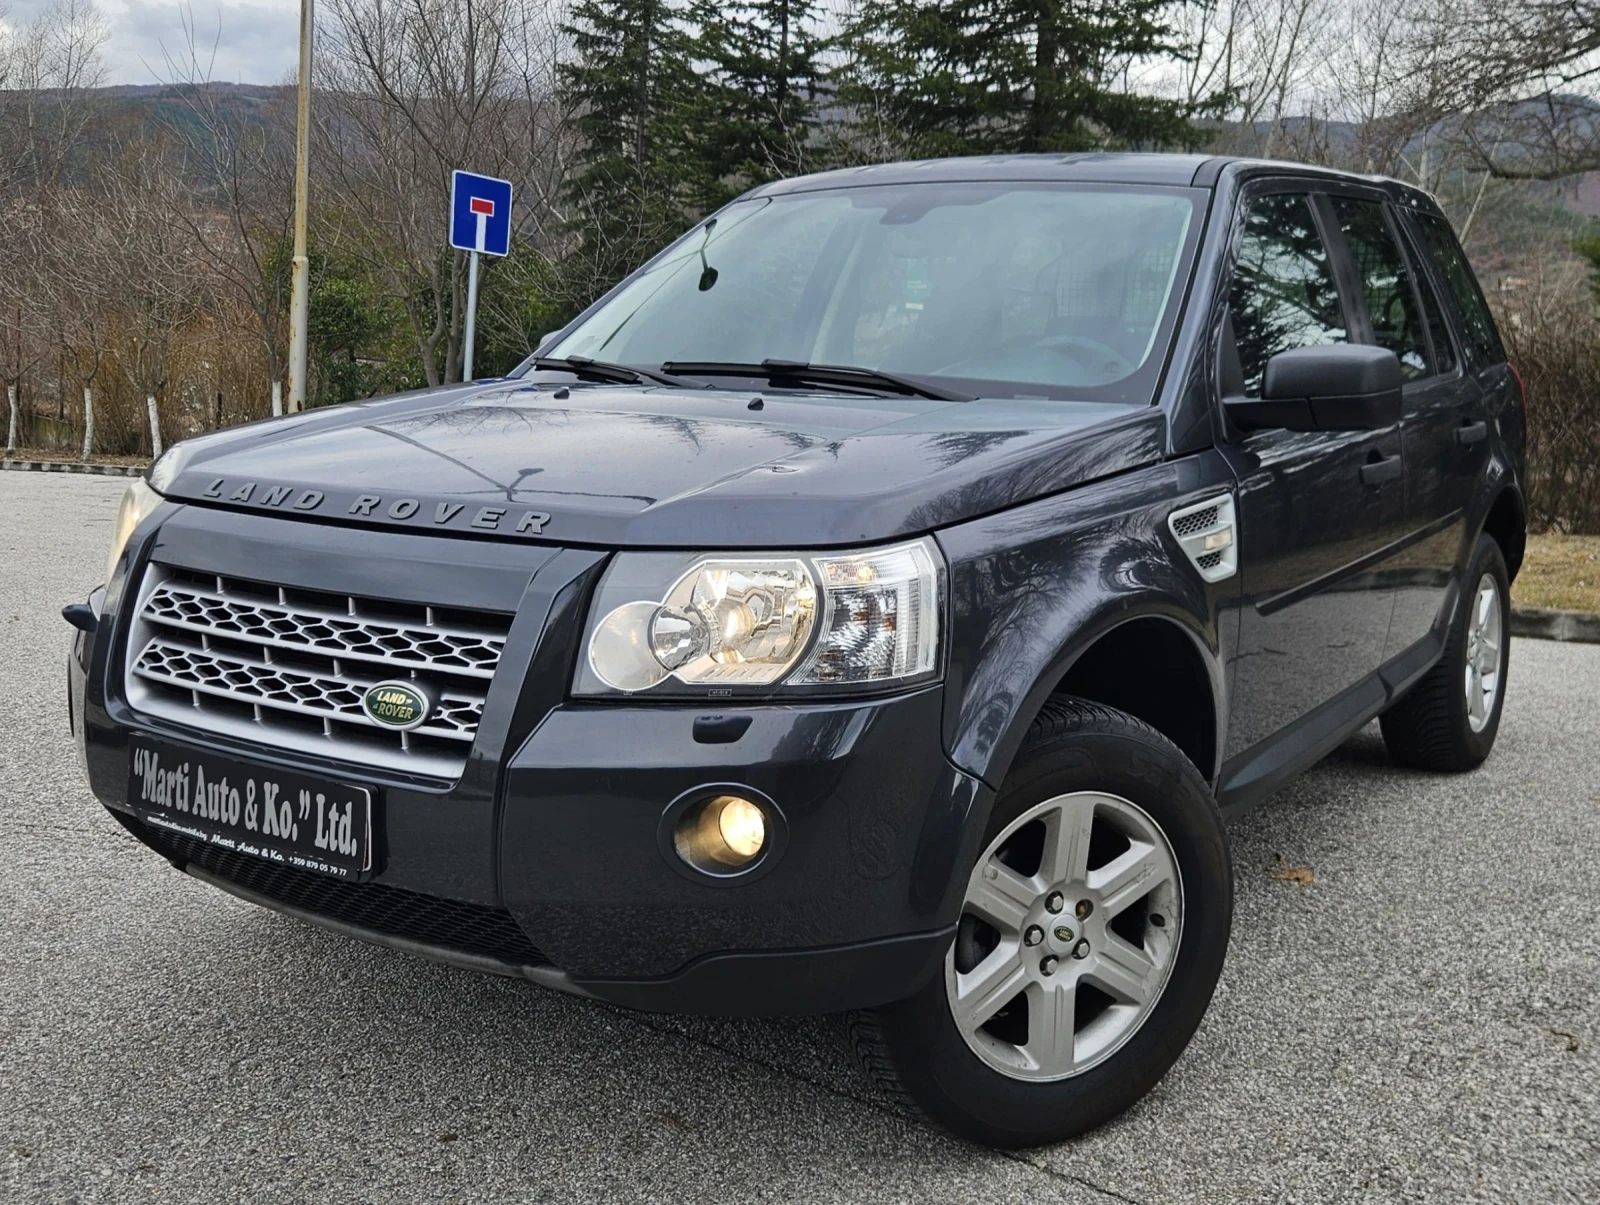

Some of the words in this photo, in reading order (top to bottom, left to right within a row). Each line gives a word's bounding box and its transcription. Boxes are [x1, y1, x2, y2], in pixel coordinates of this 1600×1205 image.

[202, 478, 325, 510] LAND
[348, 494, 551, 534] ROVER
[377, 691, 407, 705] LAND
[377, 702, 414, 719] ROVER
[134, 748, 190, 813] “Marti
[192, 764, 240, 826] Auto
[244, 778, 258, 831] &
[314, 793, 358, 857] Ltd.
[211, 834, 235, 849] Marti
[236, 842, 260, 855] Auto
[261, 848, 269, 858] &
[270, 849, 285, 862] Ko.
[288, 856, 306, 867] +359
[306, 860, 319, 870] 879
[319, 863, 329, 872] 05
[329, 866, 338, 875] 79
[339, 868, 348, 877] 77
